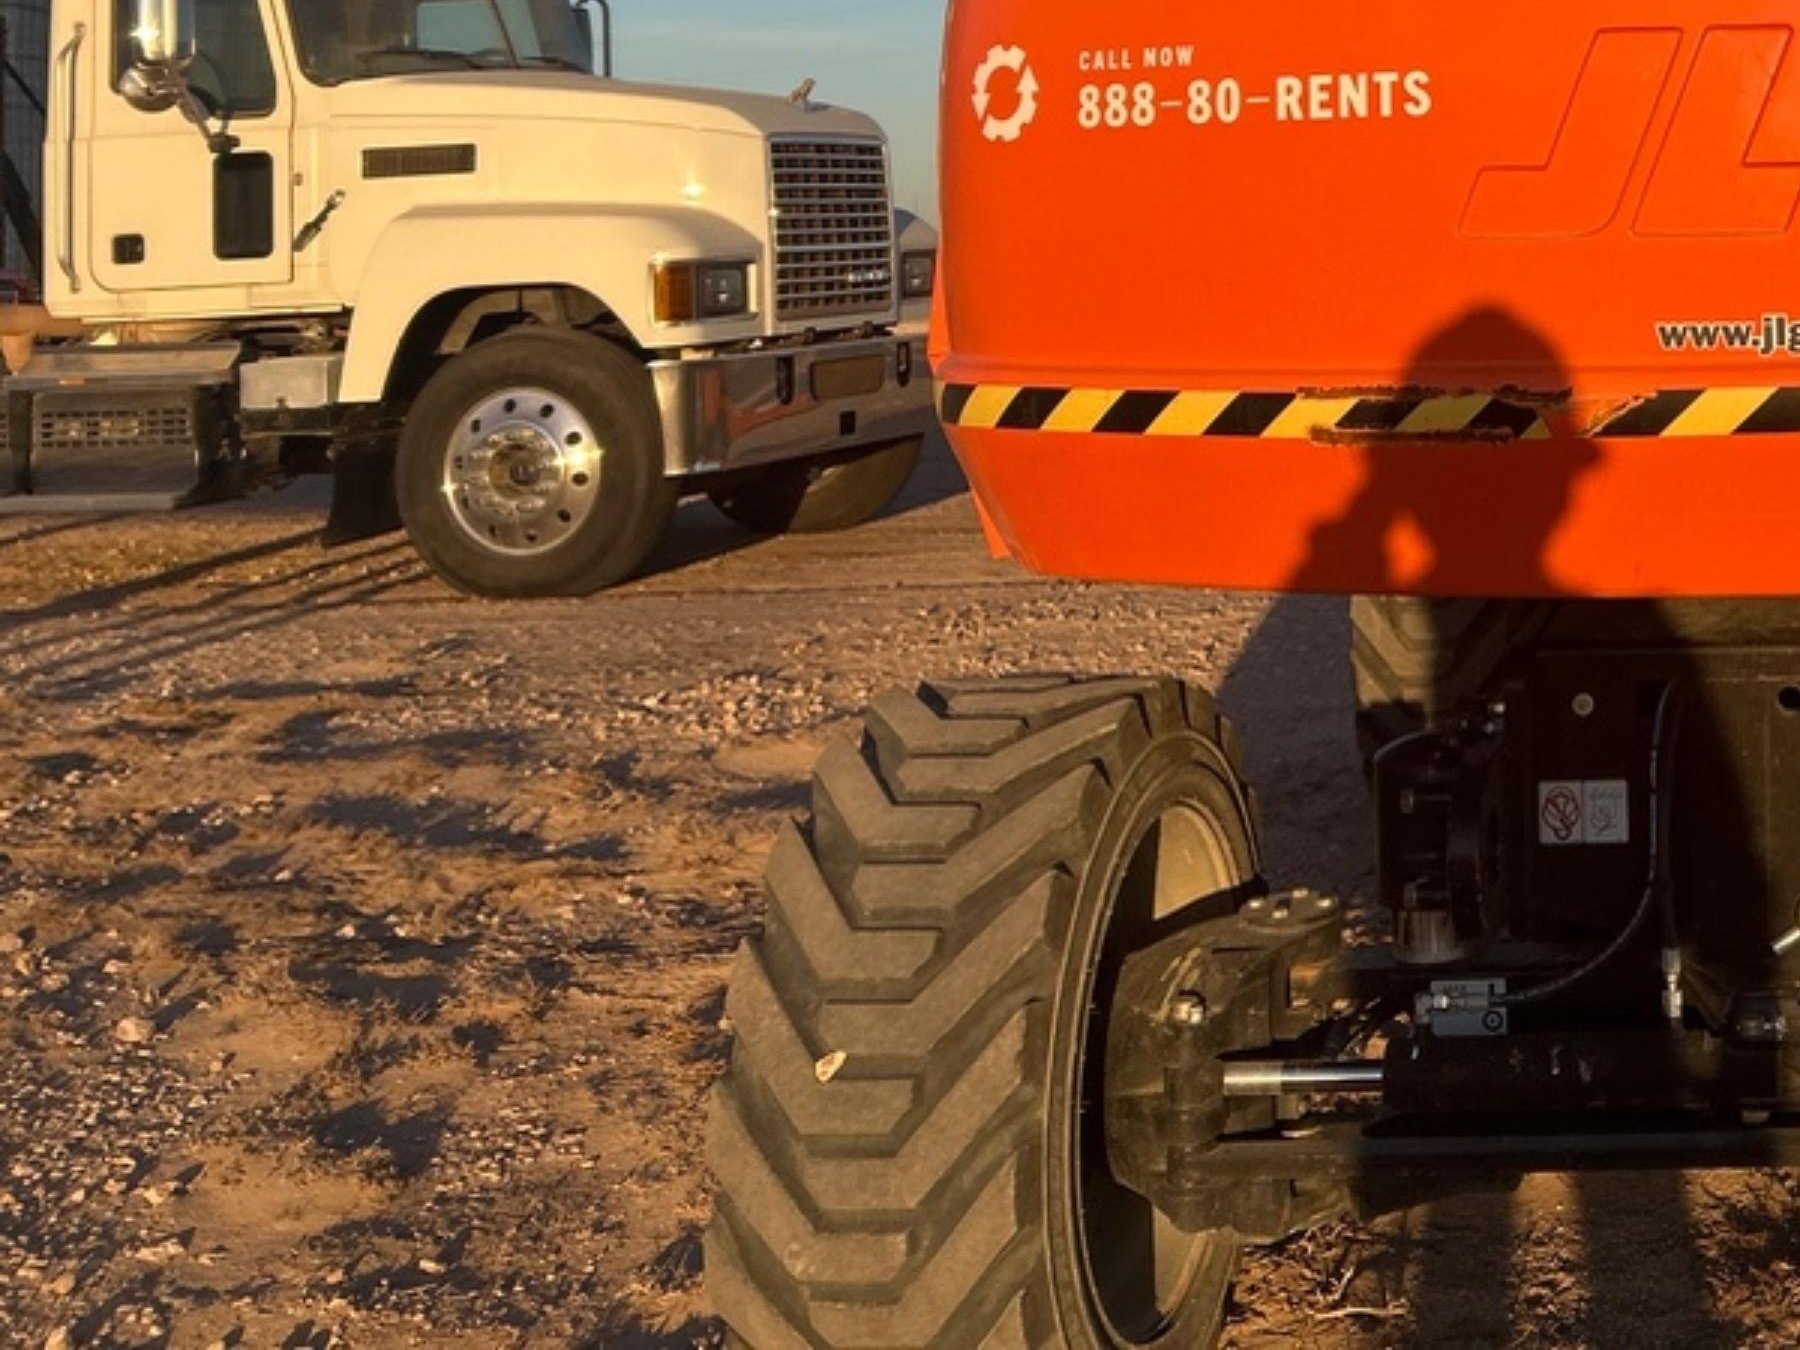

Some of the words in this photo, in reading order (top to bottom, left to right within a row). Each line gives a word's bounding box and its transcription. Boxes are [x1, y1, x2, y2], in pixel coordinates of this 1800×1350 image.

[1078, 50, 1132, 70] CALL
[1143, 45, 1195, 67] NOW
[1077, 70, 1432, 129] 888-80-RENTS
